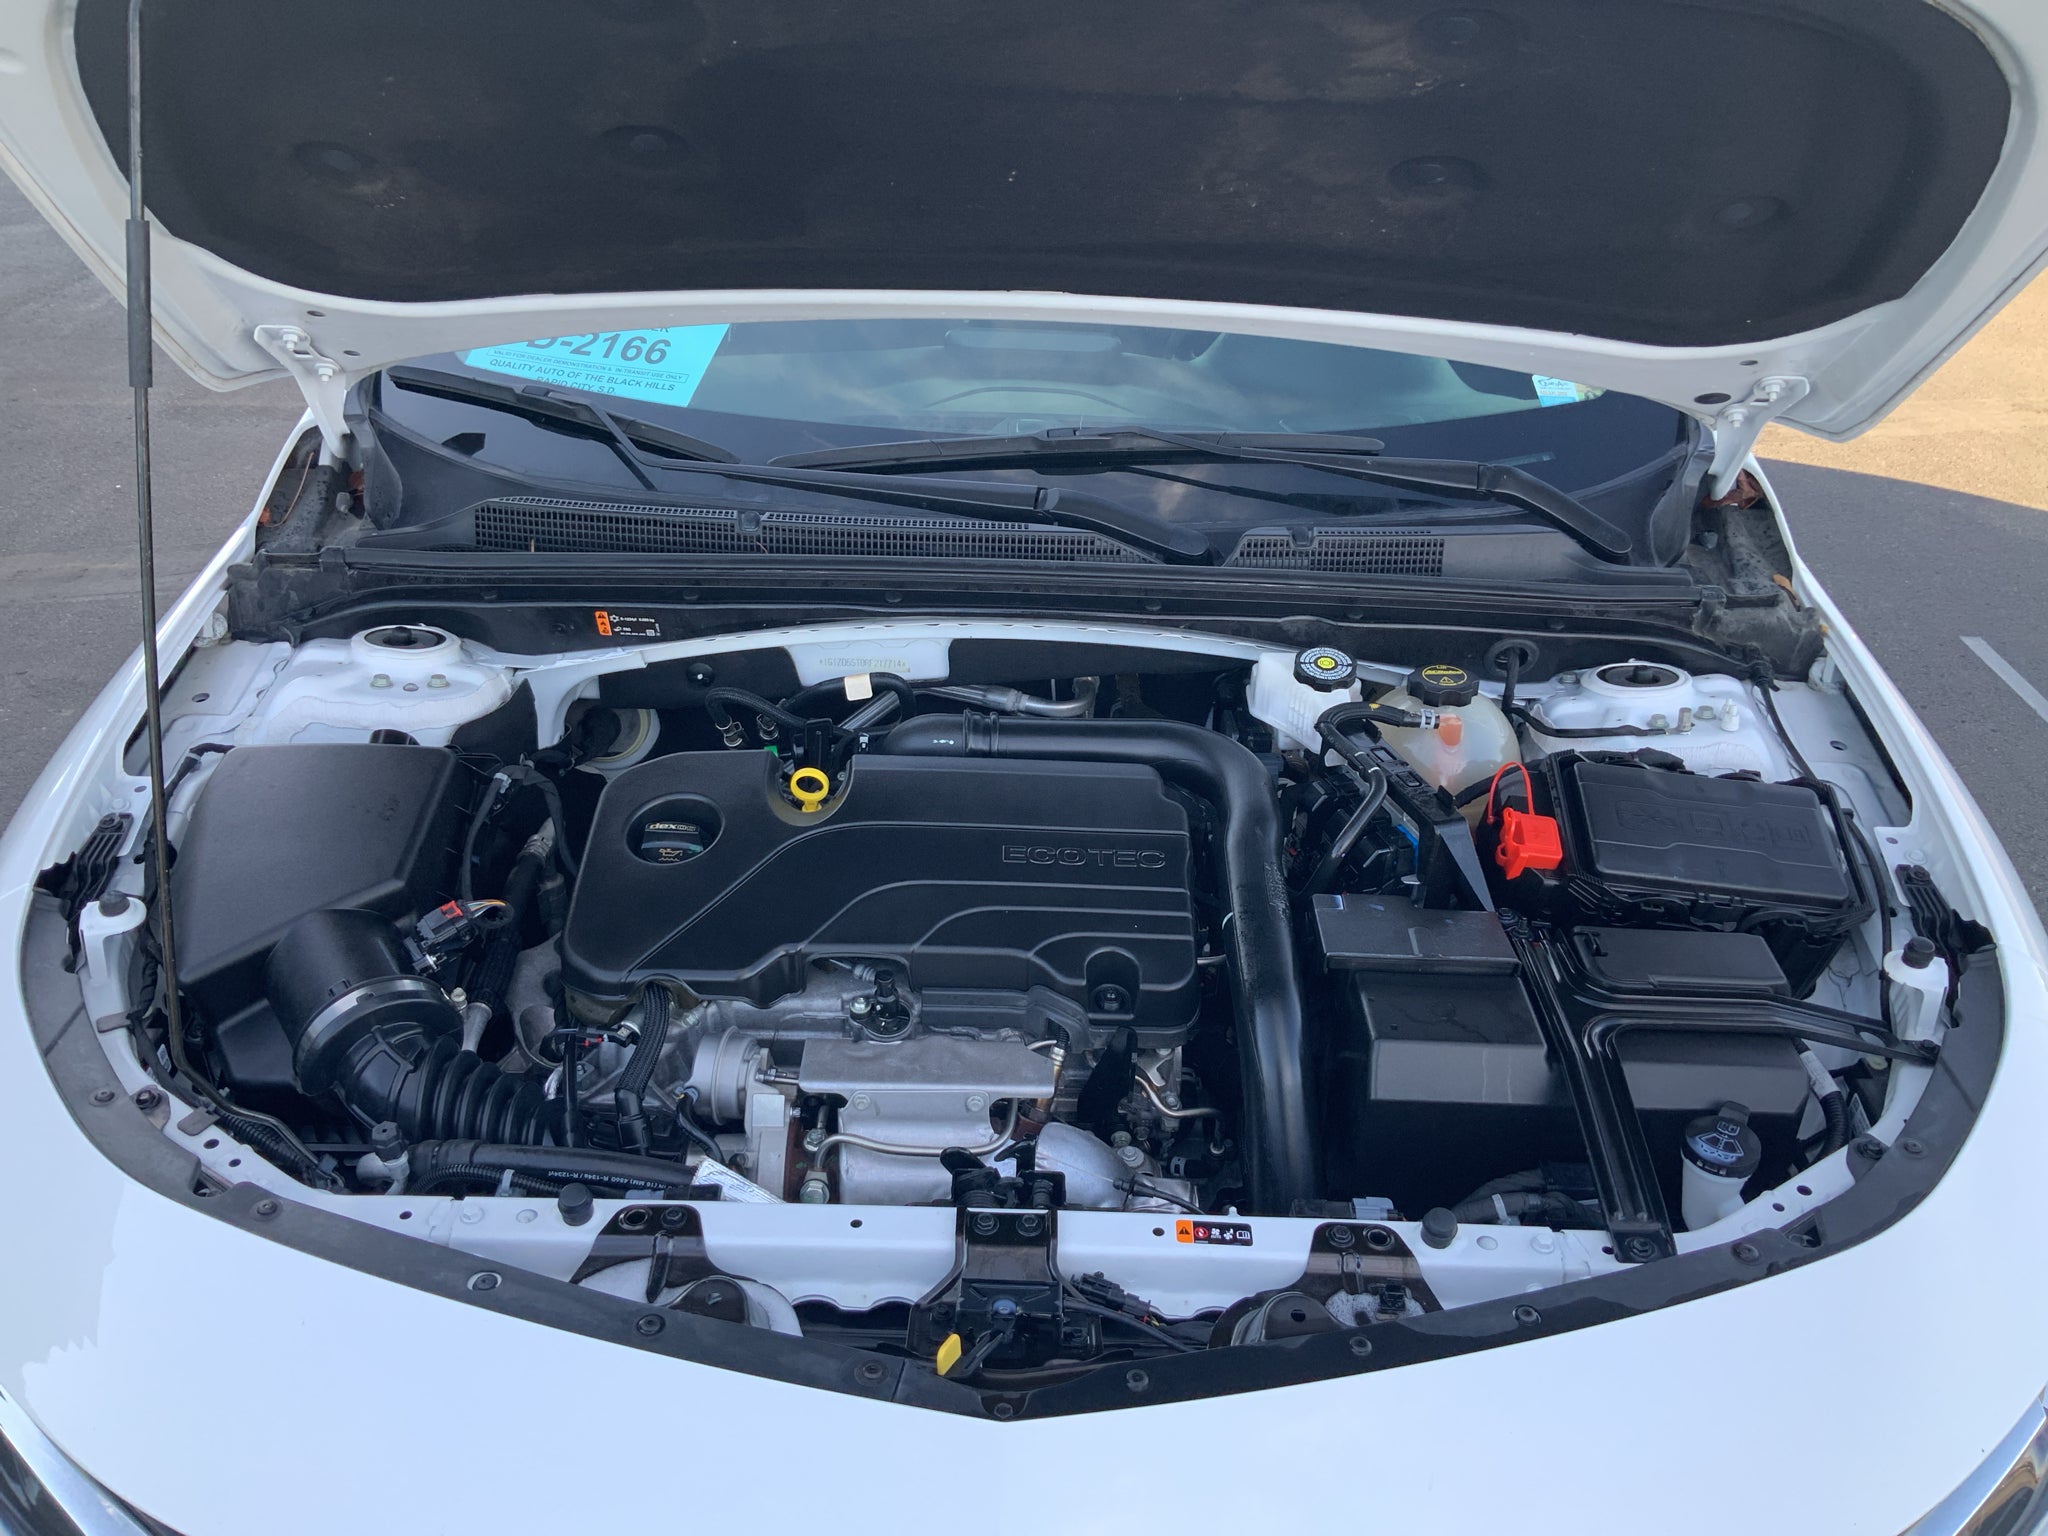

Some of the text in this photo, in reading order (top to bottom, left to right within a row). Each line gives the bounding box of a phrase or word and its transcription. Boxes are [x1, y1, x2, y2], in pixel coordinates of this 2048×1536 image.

[489, 358, 676, 391] QUALITY AUTO OF THE BLACK HILLS
[493, 349, 512, 357] VALID
[526, 354, 551, 363] DEALER
[552, 358, 606, 371] DEMONSTRATION
[665, 373, 683, 381] ONLY
[596, 385, 616, 394] S.D.
[1001, 844, 1167, 869] ECOTEC
[548, 1170, 579, 1179] R-1234yf
